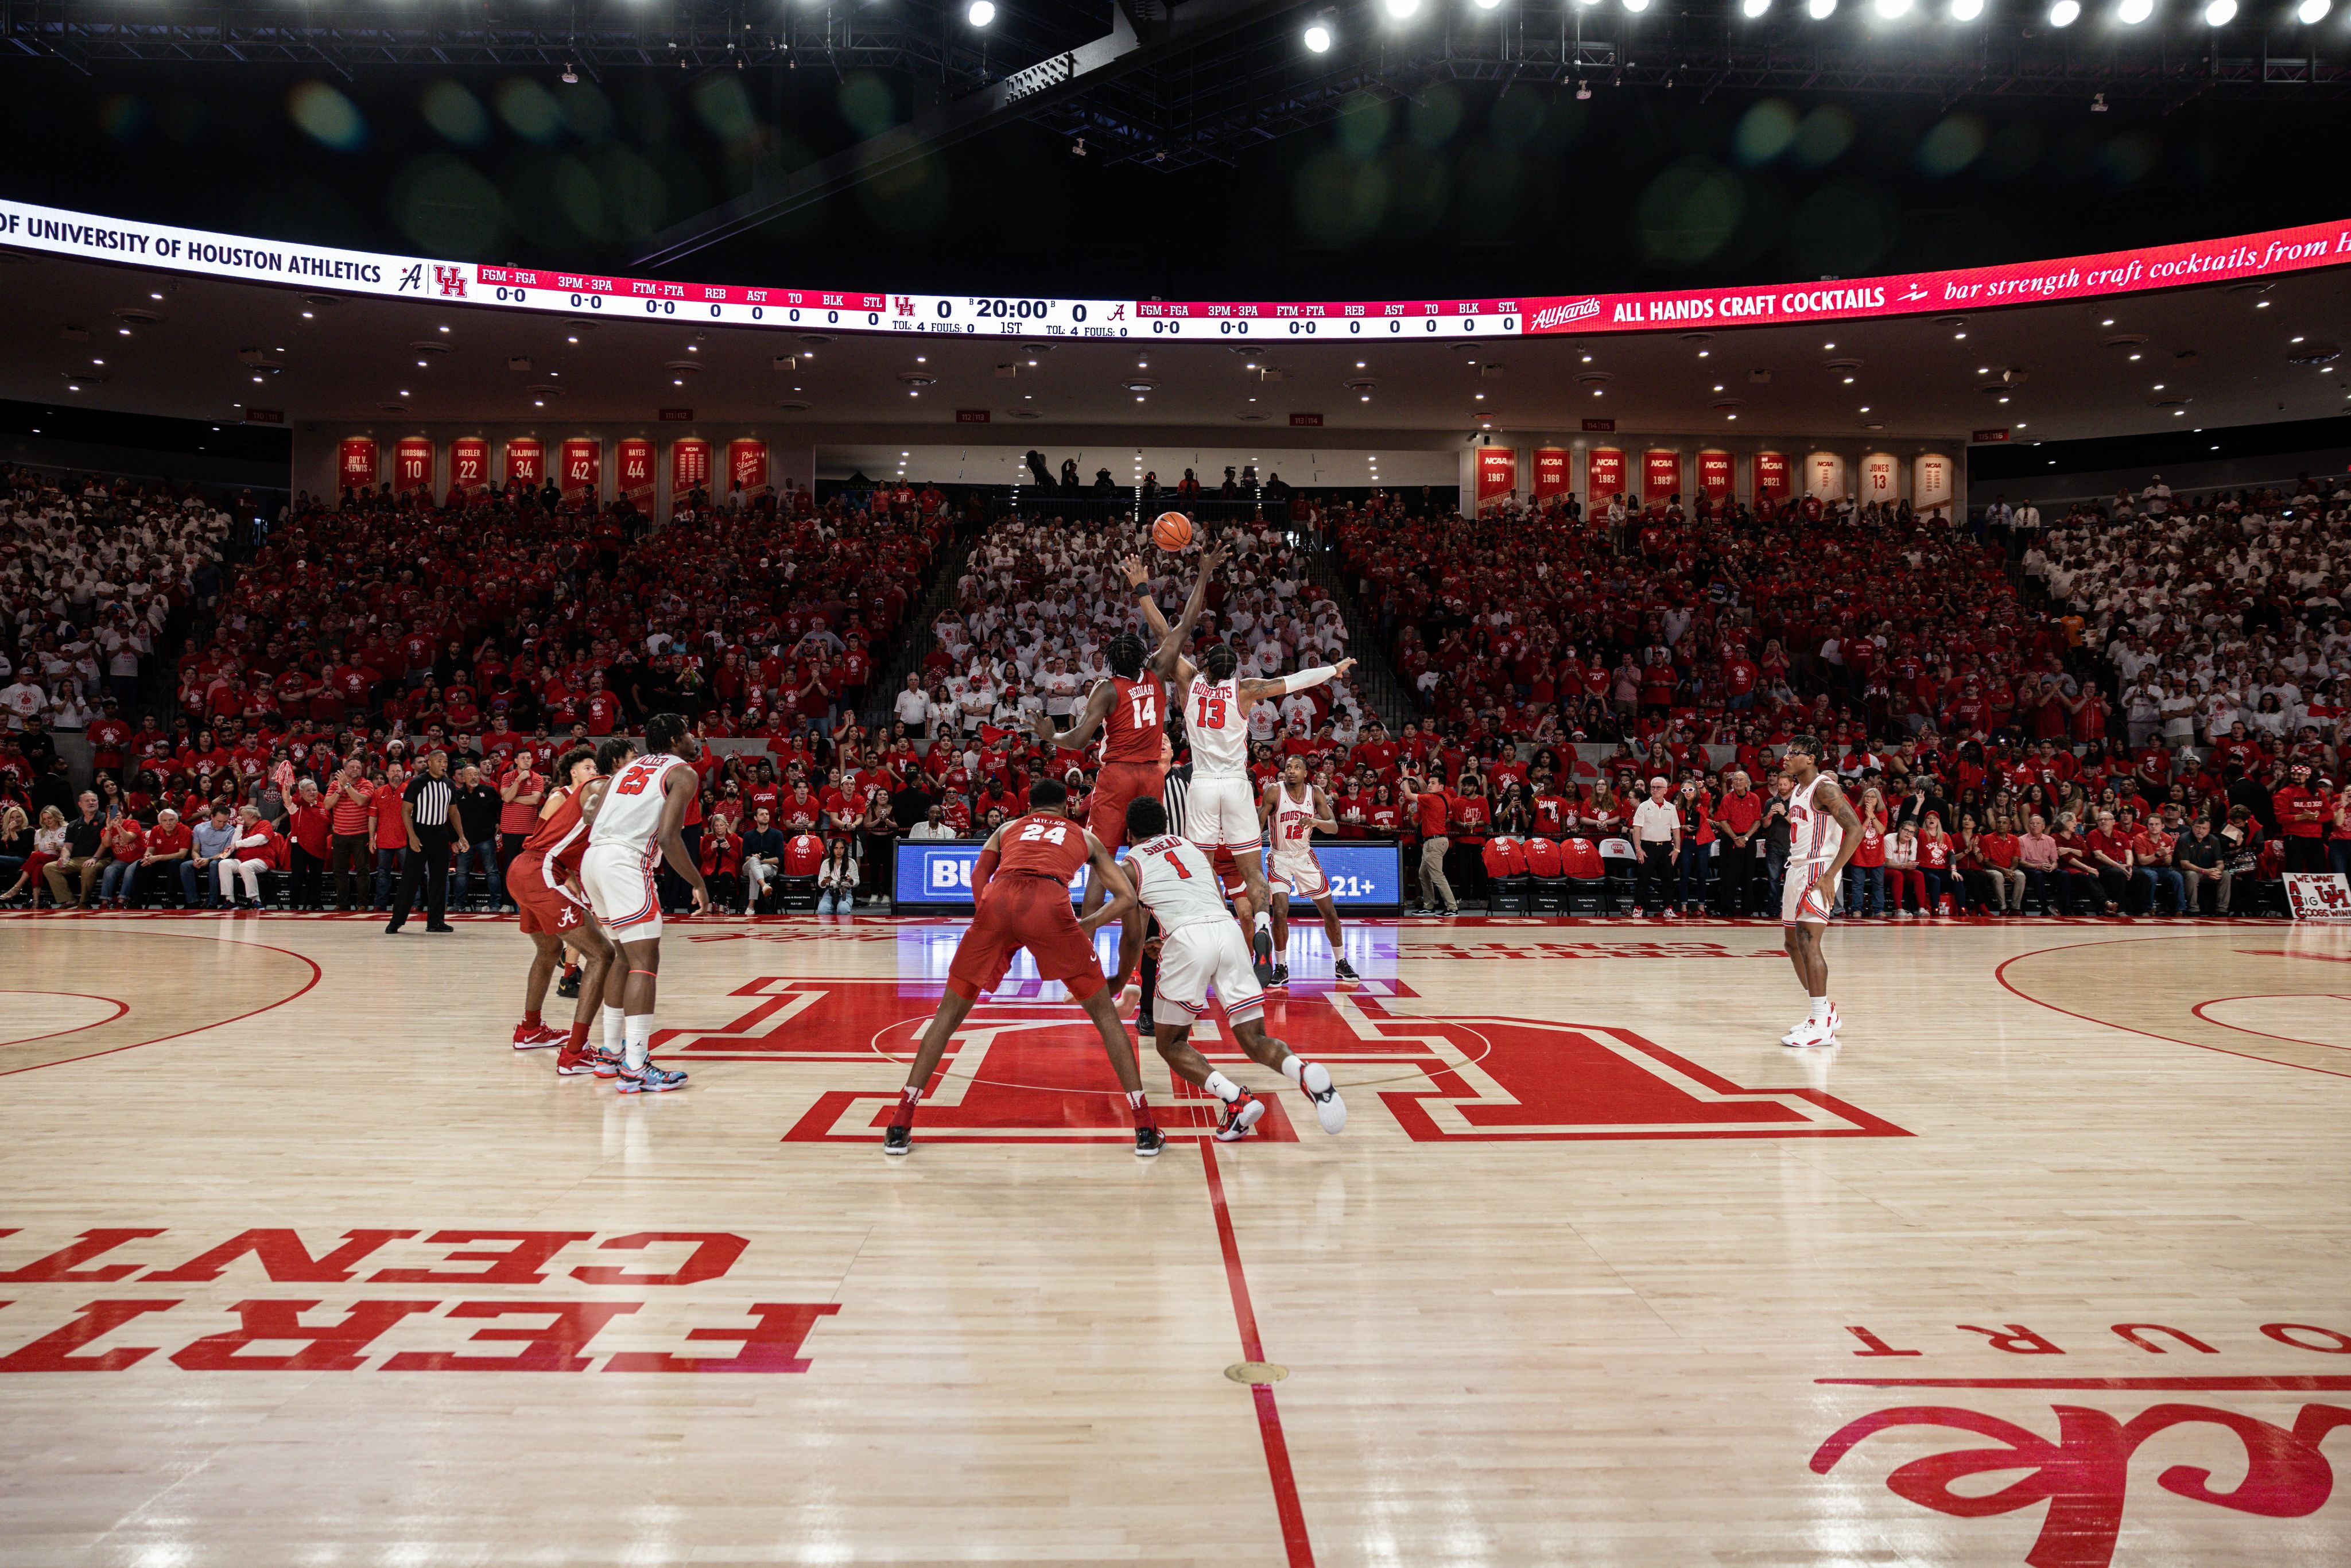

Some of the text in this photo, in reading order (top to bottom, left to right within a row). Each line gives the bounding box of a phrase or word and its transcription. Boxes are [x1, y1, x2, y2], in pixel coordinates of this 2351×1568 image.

[28, 218, 150, 254] UNIVERSITY
[155, 238, 181, 258] OF
[188, 242, 282, 271] HOUSTON
[288, 255, 381, 284] ATHLETICS
[1943, 239, 2328, 301] bar strength craft cocktails from
[558, 276, 612, 292] 3PM 3PA
[633, 282, 685, 297] FTM FTA
[496, 286, 526, 302] 0-0
[705, 288, 726, 300] REB
[746, 291, 767, 302] AST
[789, 293, 802, 304] TO
[823, 294, 844, 306] BLK
[863, 297, 883, 308] STL
[1458, 303, 1479, 313] BLK
[1498, 302, 1518, 312] STL
[1613, 287, 1885, 322] ALL HANDS CRAFT COCKTAILS
[710, 304, 721, 317] 0
[752, 306, 763, 319] 0
[789, 309, 800, 321] 0
[937, 301, 952, 318] 0
[976, 299, 1048, 319] 20:00
[1072, 304, 1087, 322] 0
[1208, 306, 1258, 316] 3PM 3PA
[1277, 306, 1325, 316] FTM FTA
[1345, 306, 1365, 316] REB
[1384, 305, 1405, 315] AST
[1425, 304, 1438, 315] TO
[828, 311, 839, 323] 0
[868, 313, 879, 325] 0
[893, 320, 975, 333] TOL: 4 FOULS: 0
[1000, 323, 1022, 333] 1ST
[1350, 321, 1360, 333] 0
[1390, 320, 1400, 333] 0
[1426, 320, 1437, 332] 0
[1464, 319, 1475, 331] 0
[1503, 317, 1514, 330] 0
[1046, 325, 1128, 336] TOL: 4 FOULS: 0
[348, 456, 368, 464] GUY V.
[742, 451, 752, 461] Phi
[348, 464, 367, 472] LEWIS
[405, 460, 421, 478] 10
[460, 461, 476, 478] 22
[516, 461, 533, 478] 34
[571, 461, 589, 480] 42
[627, 461, 645, 478] 44
[736, 459, 758, 471] Slama
[1869, 464, 1889, 472] JONES
[739, 467, 757, 482] Jama
[1488, 473, 1504, 482] 1967
[1543, 475, 1559, 483] 1968
[1599, 475, 1615, 483] 1982
[1654, 476, 1670, 485] 1983
[1708, 477, 1725, 485] 1984
[1763, 478, 1780, 486] 2021
[1873, 475, 1886, 489] 13
[1481, 496, 1497, 507] FINAL
[1593, 498, 1609, 508] FINAL
[1128, 684, 1154, 698] BEDIAKO
[1192, 681, 1232, 698] ROBERTS
[1132, 697, 1156, 729] 14
[1197, 697, 1226, 729] 13
[100, 727, 120, 736] SPACE CITY
[196, 759, 216, 769] SPACE CITY
[616, 766, 657, 795] 25
[1499, 773, 1511, 781] SPACE
[754, 794, 775, 802] Cougars
[1019, 824, 1068, 845] 24
[1285, 825, 1303, 840] 12
[1142, 835, 1182, 856] SHEAD
[1164, 851, 1192, 879] 1
[2294, 875, 2334, 883] WE WANT
[1332, 876, 1375, 896] 21+
[2289, 881, 2301, 895] A
[2291, 895, 2318, 907] BIG
[2295, 907, 2329, 918] COOGS
